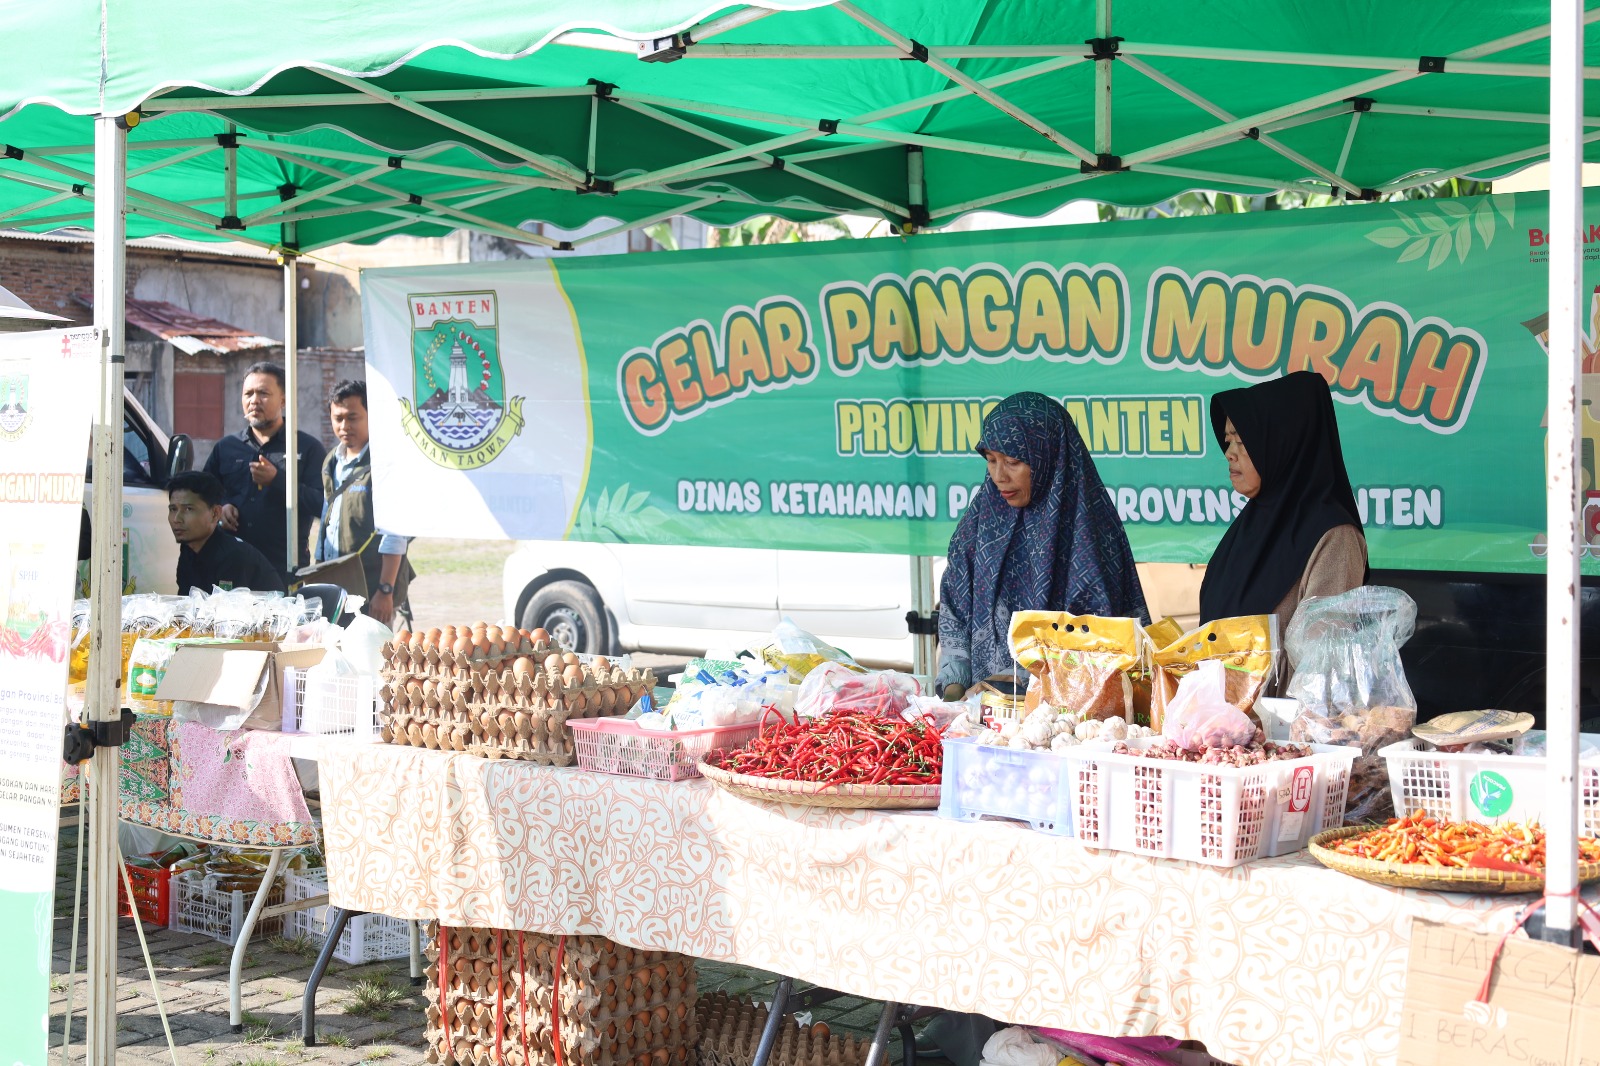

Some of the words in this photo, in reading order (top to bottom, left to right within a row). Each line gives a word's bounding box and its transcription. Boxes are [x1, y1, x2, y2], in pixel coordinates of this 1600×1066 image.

[415, 299, 491, 316] BANTEN
[620, 299, 815, 430] GELAR
[824, 267, 1125, 371] PANGAN
[1146, 273, 1481, 428] MURAH
[838, 400, 1000, 454] PROVIN
[1066, 399, 1203, 454] ANTEN
[413, 431, 449, 463] IMAN
[457, 436, 506, 466] TAQWA
[38, 472, 85, 504] MURA
[677, 480, 761, 513] DINAS
[771, 482, 936, 518] KETAHANAN
[1105, 487, 1250, 522] ROVINS
[1353, 487, 1441, 526] NTEN
[18, 689, 52, 703] Provinsi
[0, 777, 23, 790] SOKAN
[24, 781, 39, 792] DAN
[20, 793, 46, 806] PANGAN
[9, 849, 45, 865] SEJAHTERA
[1436, 1018, 1529, 1062] BERAS
